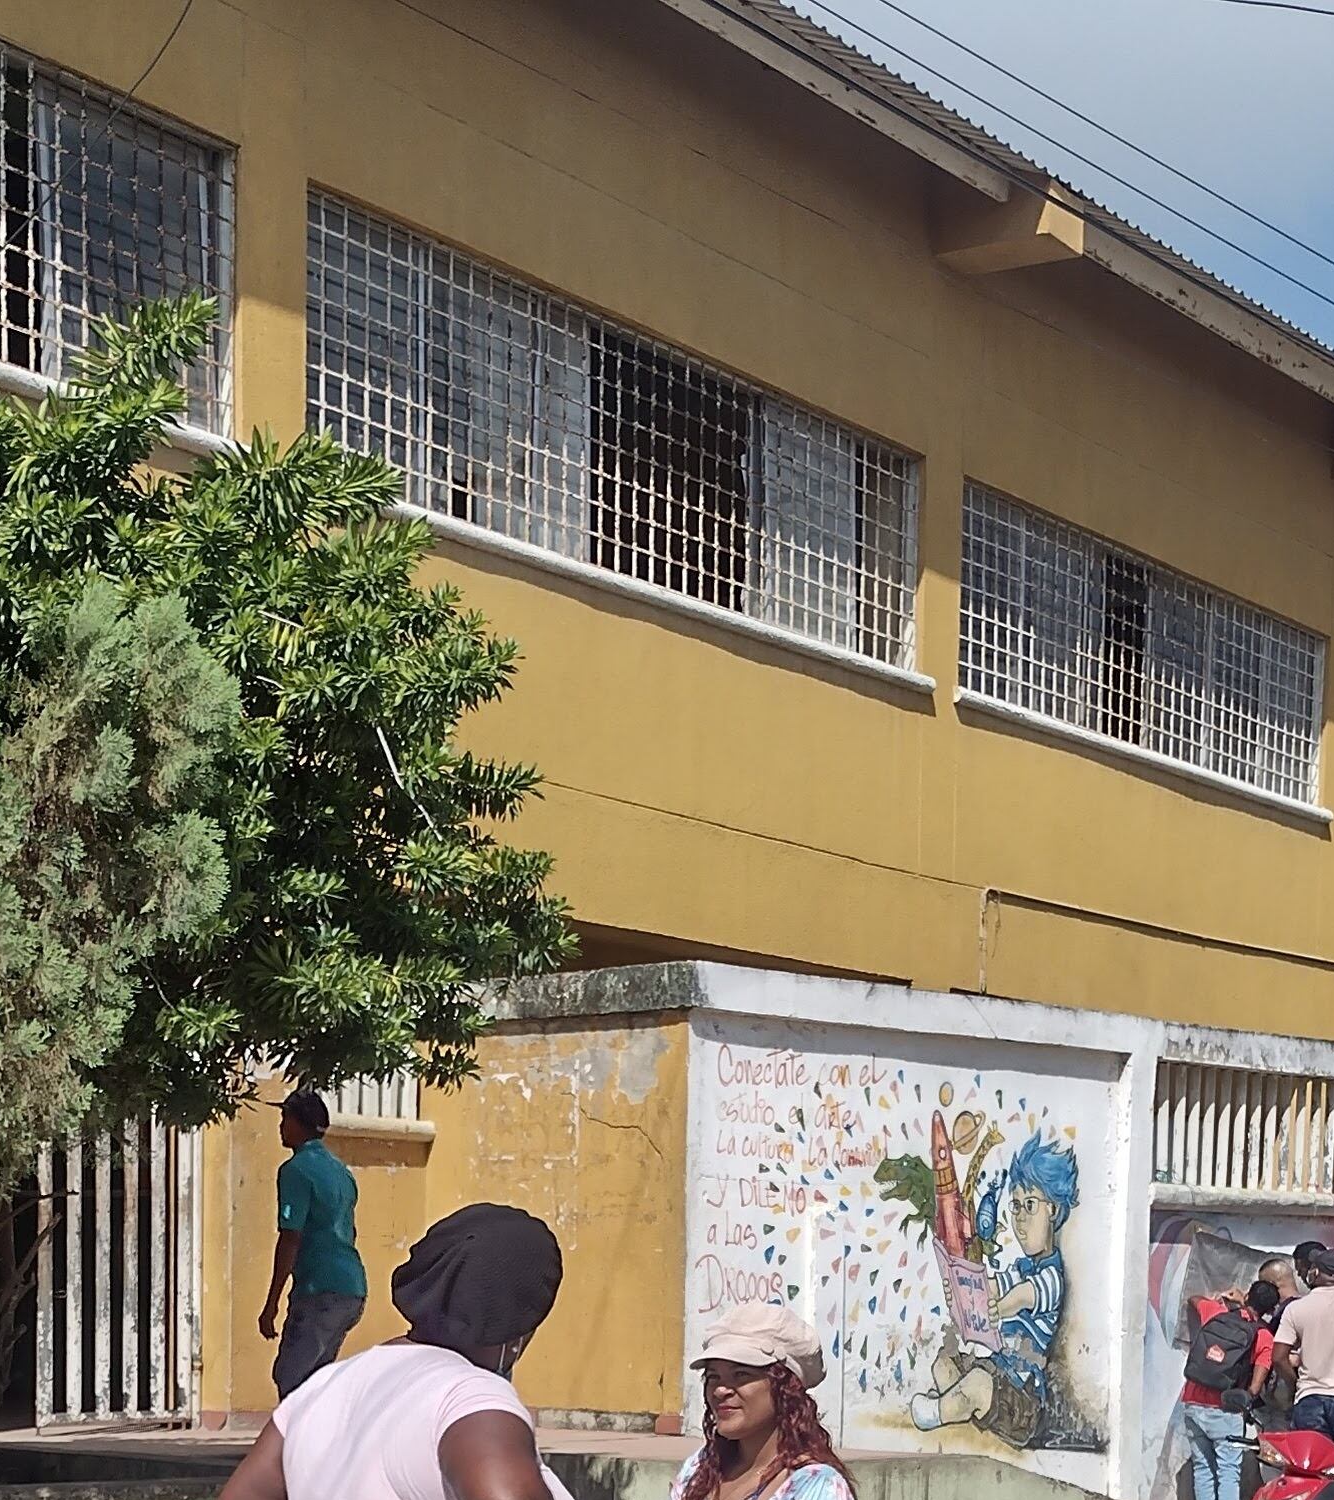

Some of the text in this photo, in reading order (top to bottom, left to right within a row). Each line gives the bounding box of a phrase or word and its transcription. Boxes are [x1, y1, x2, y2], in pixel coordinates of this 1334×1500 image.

[817, 1062, 851, 1087] con
[859, 1053, 887, 1087] el
[718, 1091, 775, 1126] estudio
[788, 1093, 805, 1126] el
[742, 1135, 795, 1164] cultura
